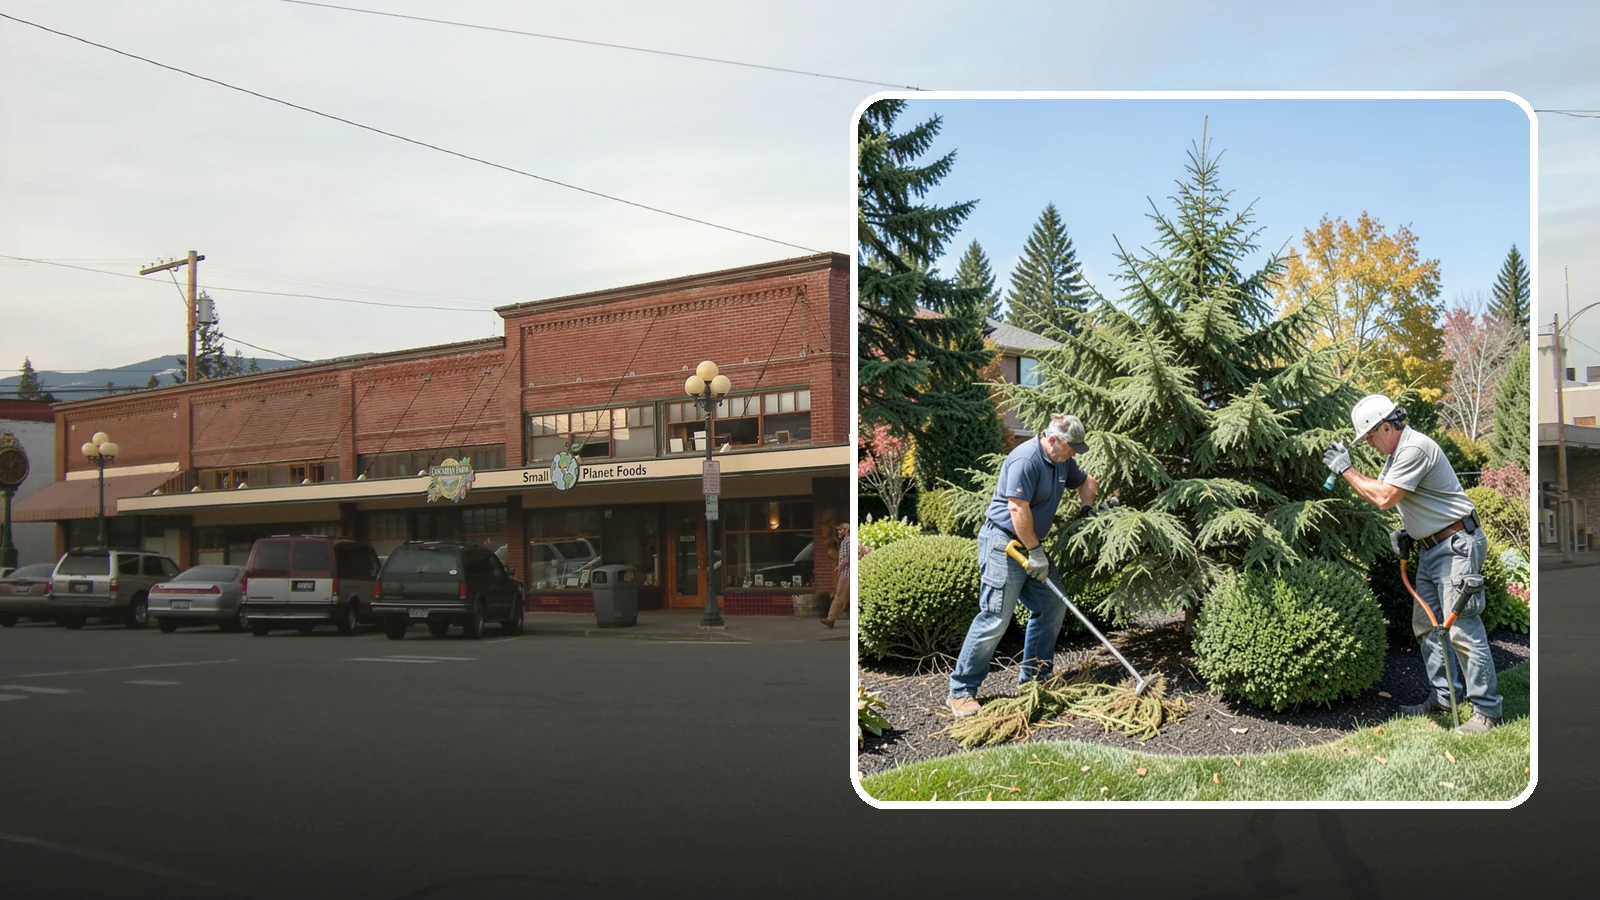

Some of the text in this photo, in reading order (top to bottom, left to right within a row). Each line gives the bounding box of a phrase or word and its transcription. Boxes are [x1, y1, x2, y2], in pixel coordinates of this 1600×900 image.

[432, 466, 469, 476] CASCADIAN FARM
[523, 464, 646, 482] Small Planet Foods
